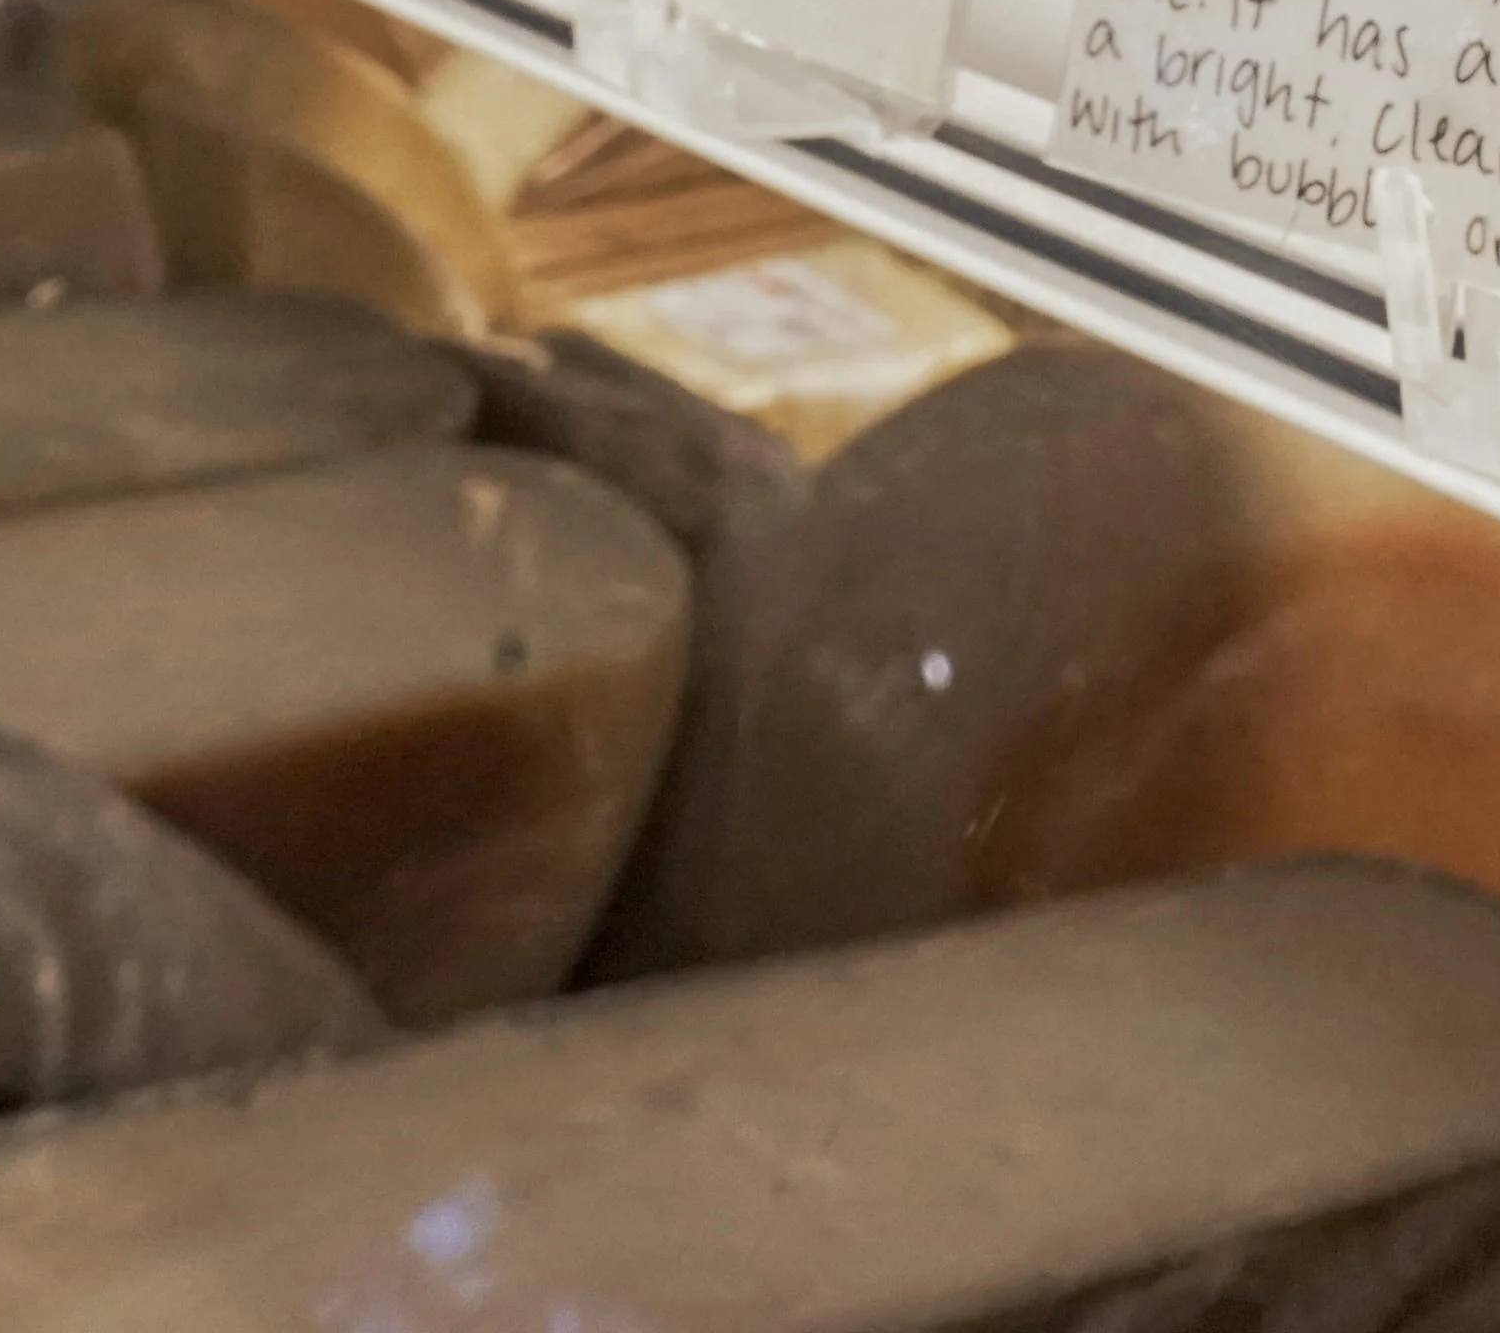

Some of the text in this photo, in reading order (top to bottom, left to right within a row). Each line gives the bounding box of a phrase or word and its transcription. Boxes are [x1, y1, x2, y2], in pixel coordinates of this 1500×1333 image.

[1084, 17, 1122, 62] a
[1454, 39, 1499, 87] a
[1070, 87, 1182, 157] with
[1230, 132, 1380, 228] bubbl
